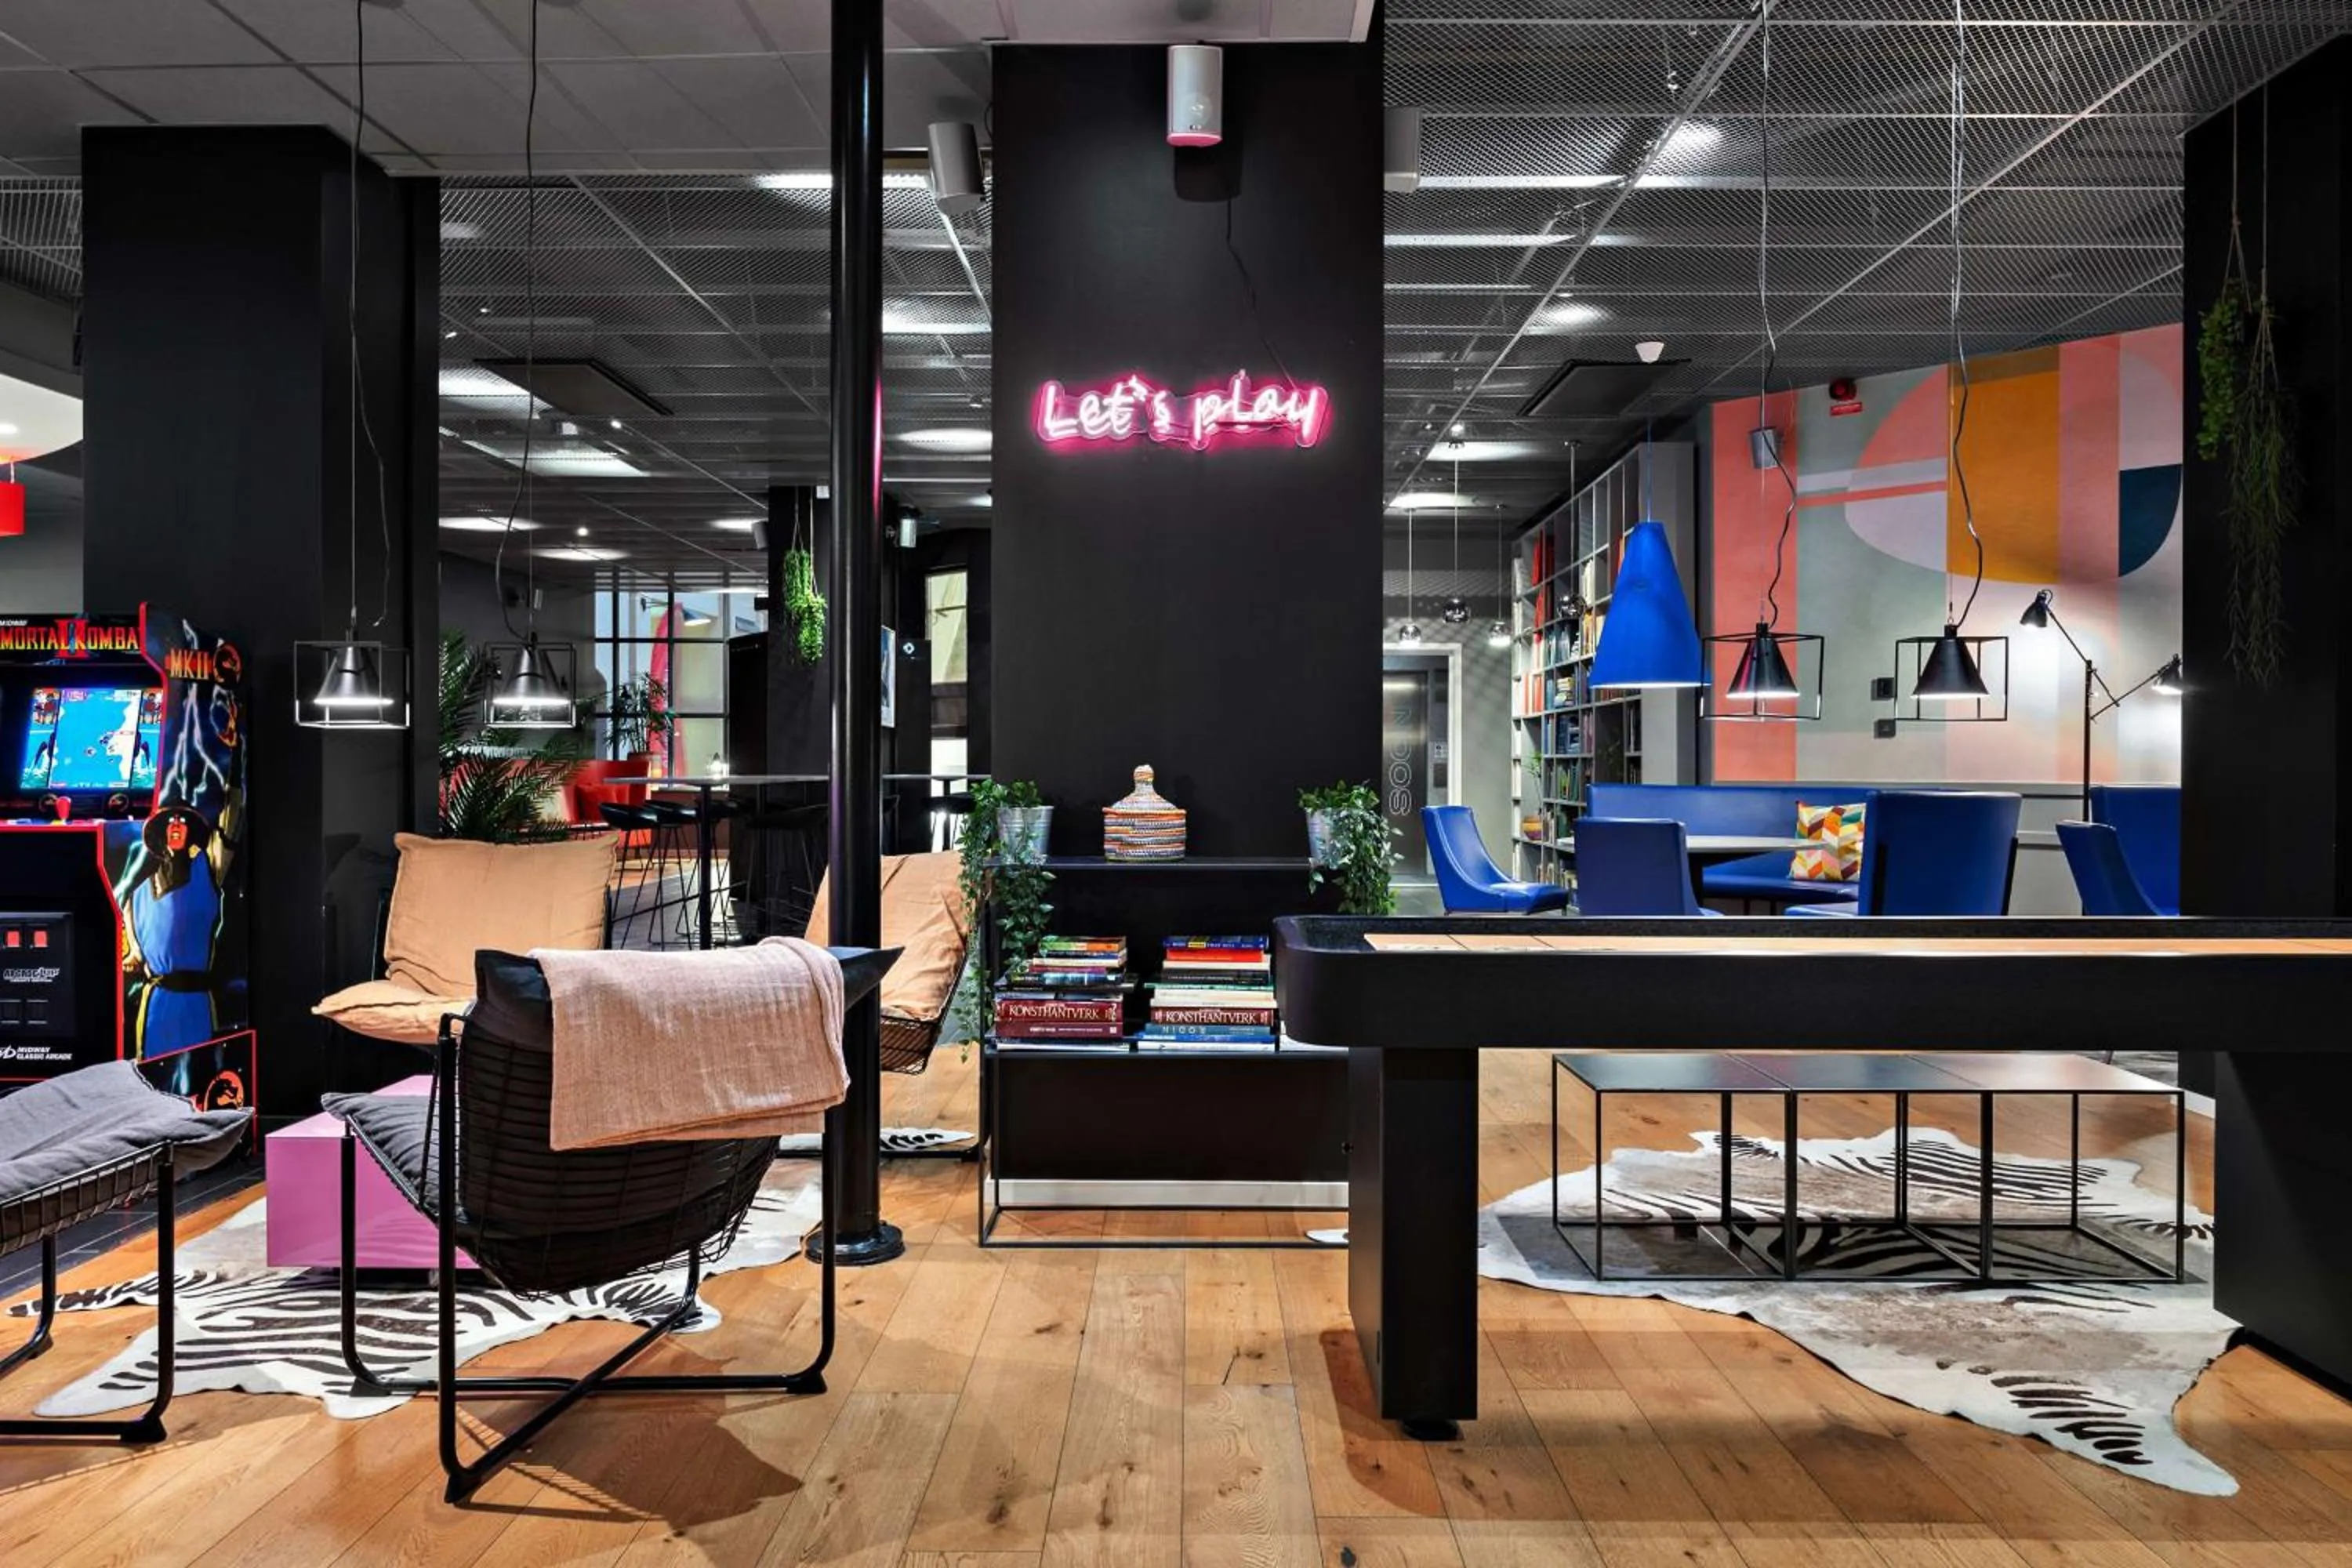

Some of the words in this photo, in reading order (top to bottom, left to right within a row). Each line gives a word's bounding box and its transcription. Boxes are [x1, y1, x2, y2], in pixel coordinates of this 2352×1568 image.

[1044, 375, 1171, 437] Let's
[1193, 370, 1320, 441] play
[0, 626, 70, 650] MORTAL
[75, 626, 140, 650] KOMBA
